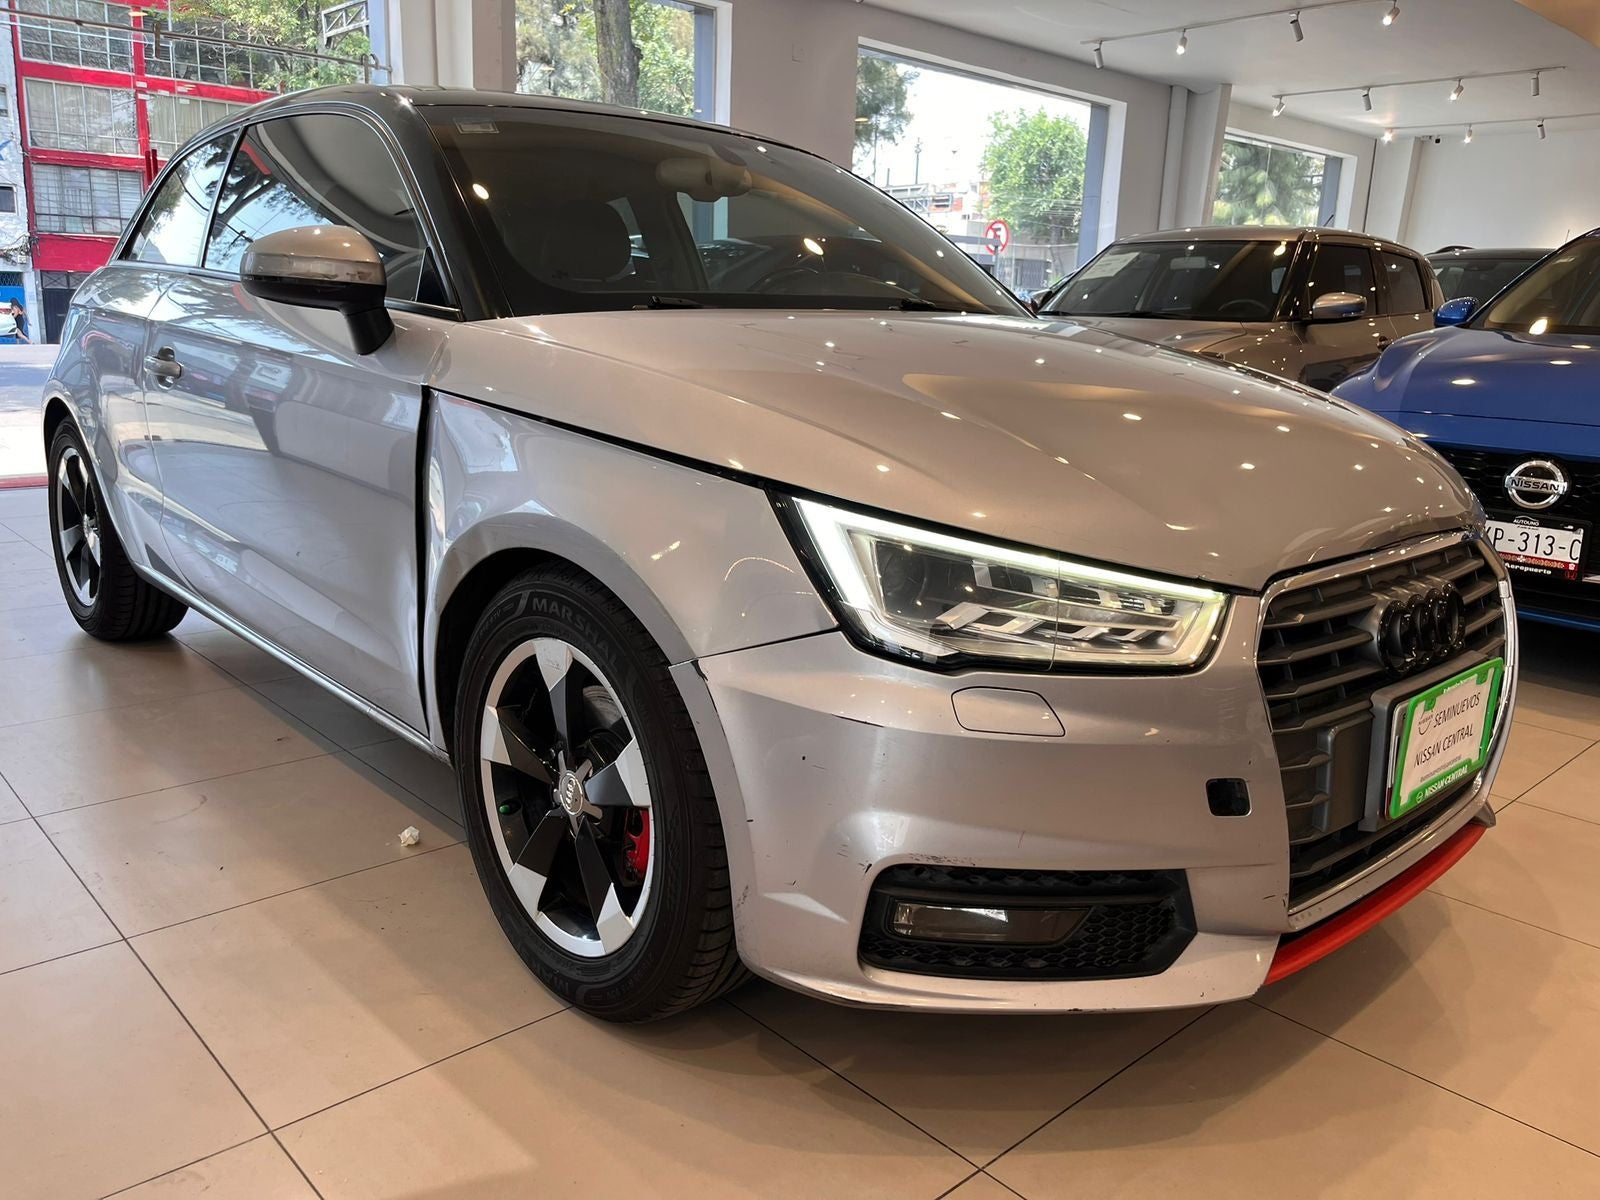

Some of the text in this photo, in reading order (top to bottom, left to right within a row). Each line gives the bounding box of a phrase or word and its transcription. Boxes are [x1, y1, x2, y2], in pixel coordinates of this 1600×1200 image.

[1510, 478, 1560, 491] NISSAN
[1433, 692, 1481, 728] SEMINUEVOS
[1414, 723, 1474, 768] NISSAN CENTRAL
[1424, 777, 1445, 798] NISSAN
[1444, 765, 1468, 787] CENTRAL
